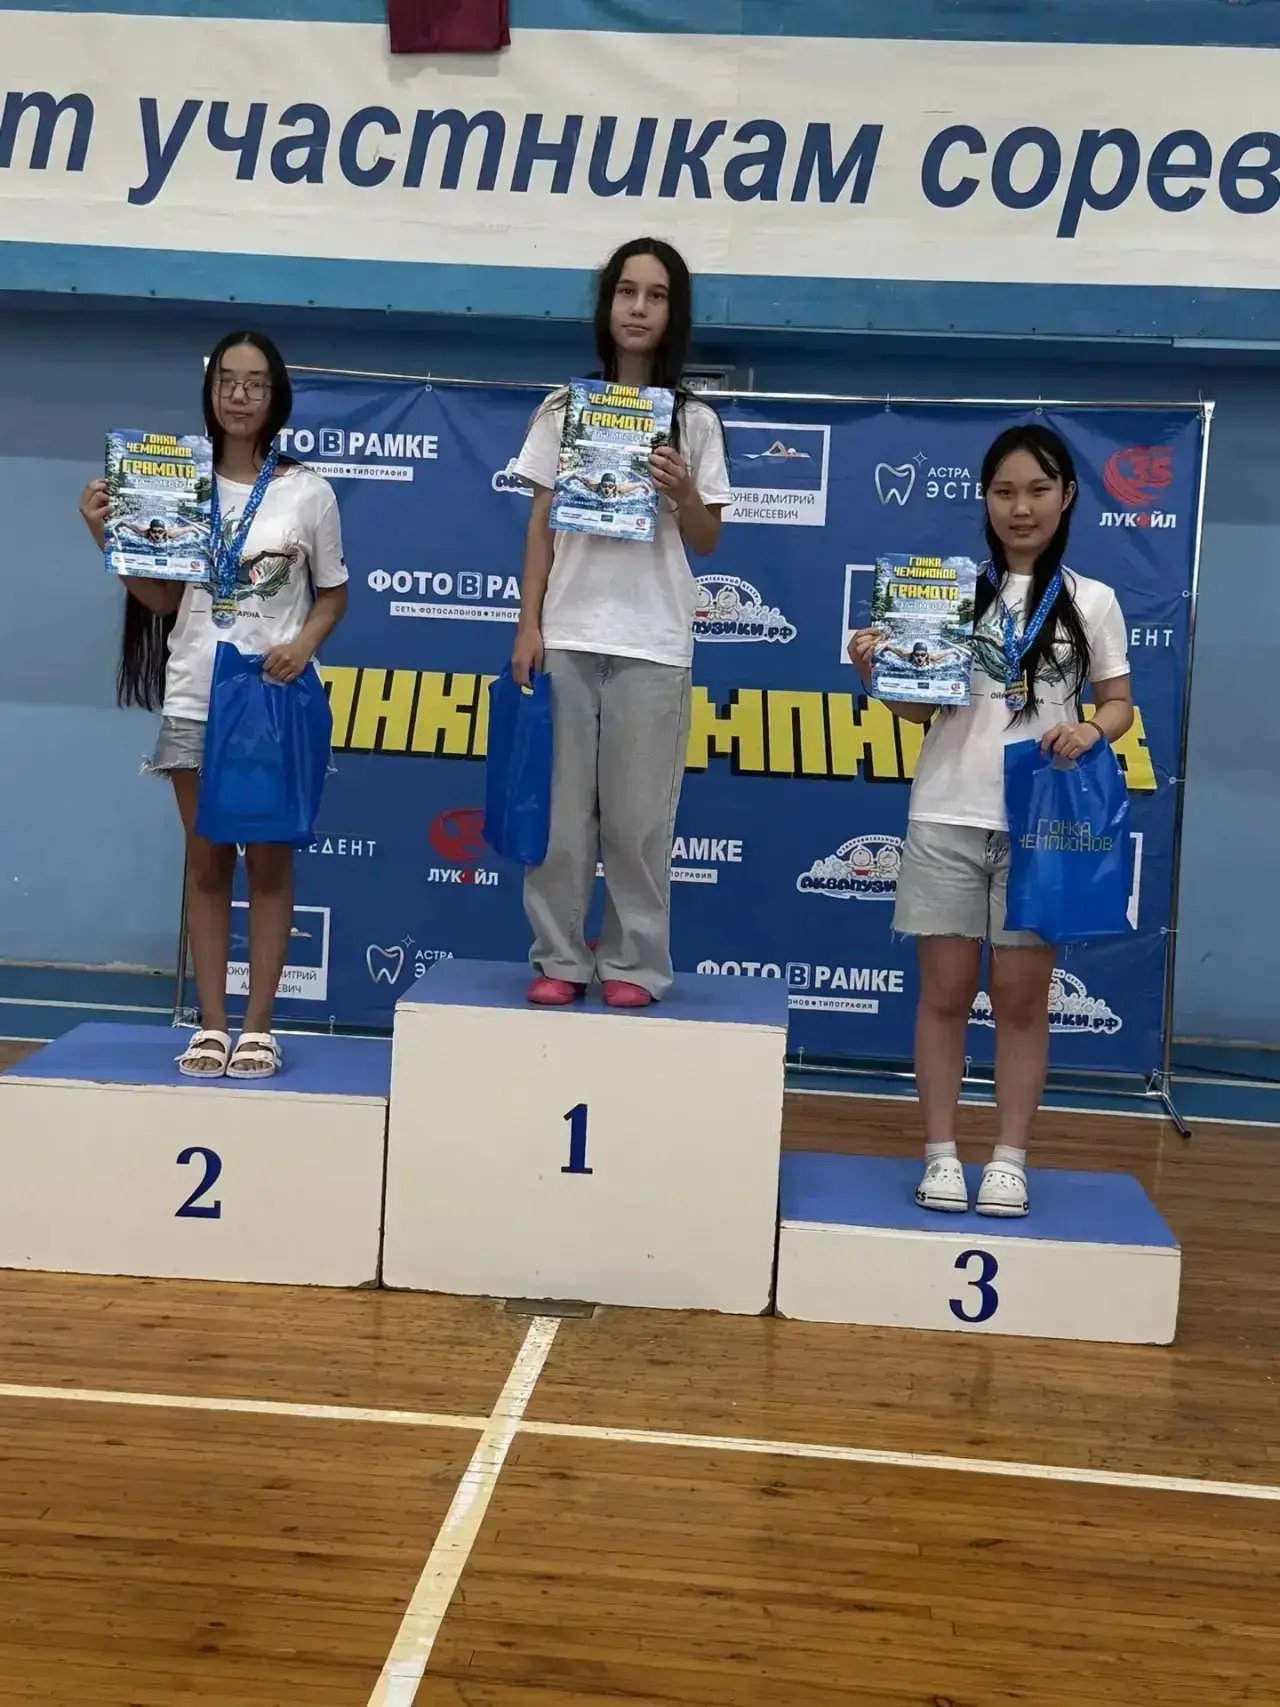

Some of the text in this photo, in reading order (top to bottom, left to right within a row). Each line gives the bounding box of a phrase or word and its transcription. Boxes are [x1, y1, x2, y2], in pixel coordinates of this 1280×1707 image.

[127, 97, 884, 205] участникам
[921, 124, 1280, 238] сорев
[589, 393, 653, 410] ЧЕМПИОНОВ
[581, 410, 655, 432] ГРАМОТА
[126, 442, 193, 458] ЧЕМПИОНОВ
[322, 430, 342, 454] В
[349, 432, 438, 459] РАМКЕ
[121, 459, 196, 478] ГРАМОТА
[353, 468, 408, 477] ТИПОГРАФИЯ
[928, 467, 971, 479] АСТРА
[761, 493, 815, 505] ДМИТРИЙ
[733, 508, 799, 519] АЛЕКСЕЕВИЧ
[909, 556, 942, 568] ГОНКА
[893, 566, 957, 579] ЧЕМПИОНОВ
[367, 569, 453, 596] ФОТО
[459, 573, 480, 597] В
[888, 583, 959, 600] ГРАМОТА
[419, 607, 482, 617] ФОТОСАЛОНОВ
[491, 611, 521, 619] ТИПОГ
[1037, 818, 1092, 837] ГОНКА
[671, 837, 743, 862] АМКЕ
[1019, 833, 1113, 852] ЧЕМПИОНОВ
[281, 970, 317, 981] ИТРИЙ
[788, 963, 808, 987] В
[814, 965, 904, 993] РАМКЕ
[818, 1000, 873, 1010] ТИПОГРАФИЯ
[561, 1103, 593, 1175] 1
[175, 1146, 223, 1219] 2
[949, 1250, 999, 1323] 3
